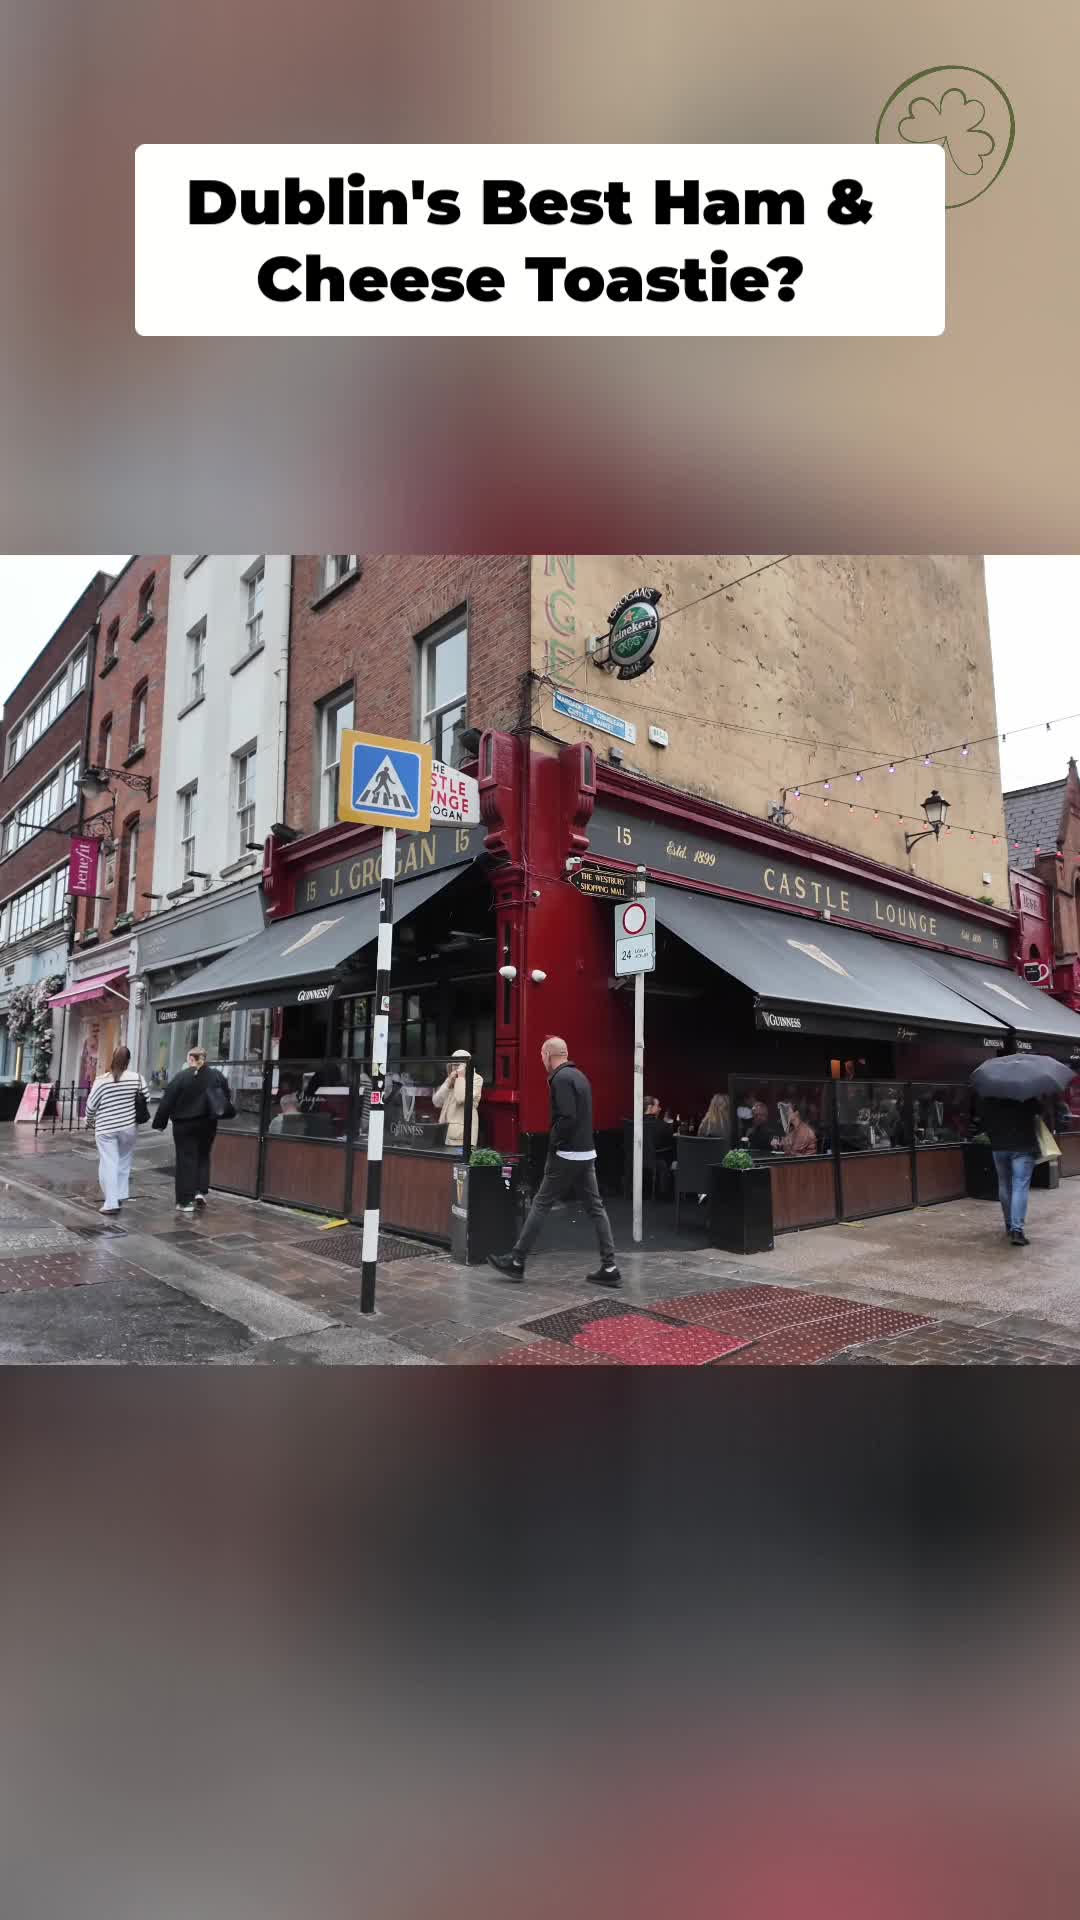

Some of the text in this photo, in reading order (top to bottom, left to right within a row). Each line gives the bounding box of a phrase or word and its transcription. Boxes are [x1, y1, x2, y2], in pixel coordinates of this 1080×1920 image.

[622, 661, 642, 676] BAR
[433, 763, 445, 775] HE
[431, 772, 466, 797] STLE
[431, 789, 469, 813] NGE
[433, 805, 463, 821] OGAN
[72, 843, 91, 891] benefit
[306, 880, 317, 901] 15
[329, 869, 343, 897] J.
[455, 829, 470, 853] 15
[580, 872, 625, 886] THE WESTBURY
[617, 826, 632, 846] 15
[666, 840, 687, 859] Estd.
[694, 850, 716, 867] 1899
[764, 868, 849, 912] CASTLE
[875, 900, 937, 936] LOUNGE
[580, 883, 608, 894] SHOPPING
[621, 950, 632, 961] 24
[297, 987, 327, 1002] GUINNESS
[769, 1014, 802, 1029] GUINNESS
[390, 1122, 424, 1137] GUINNESS
